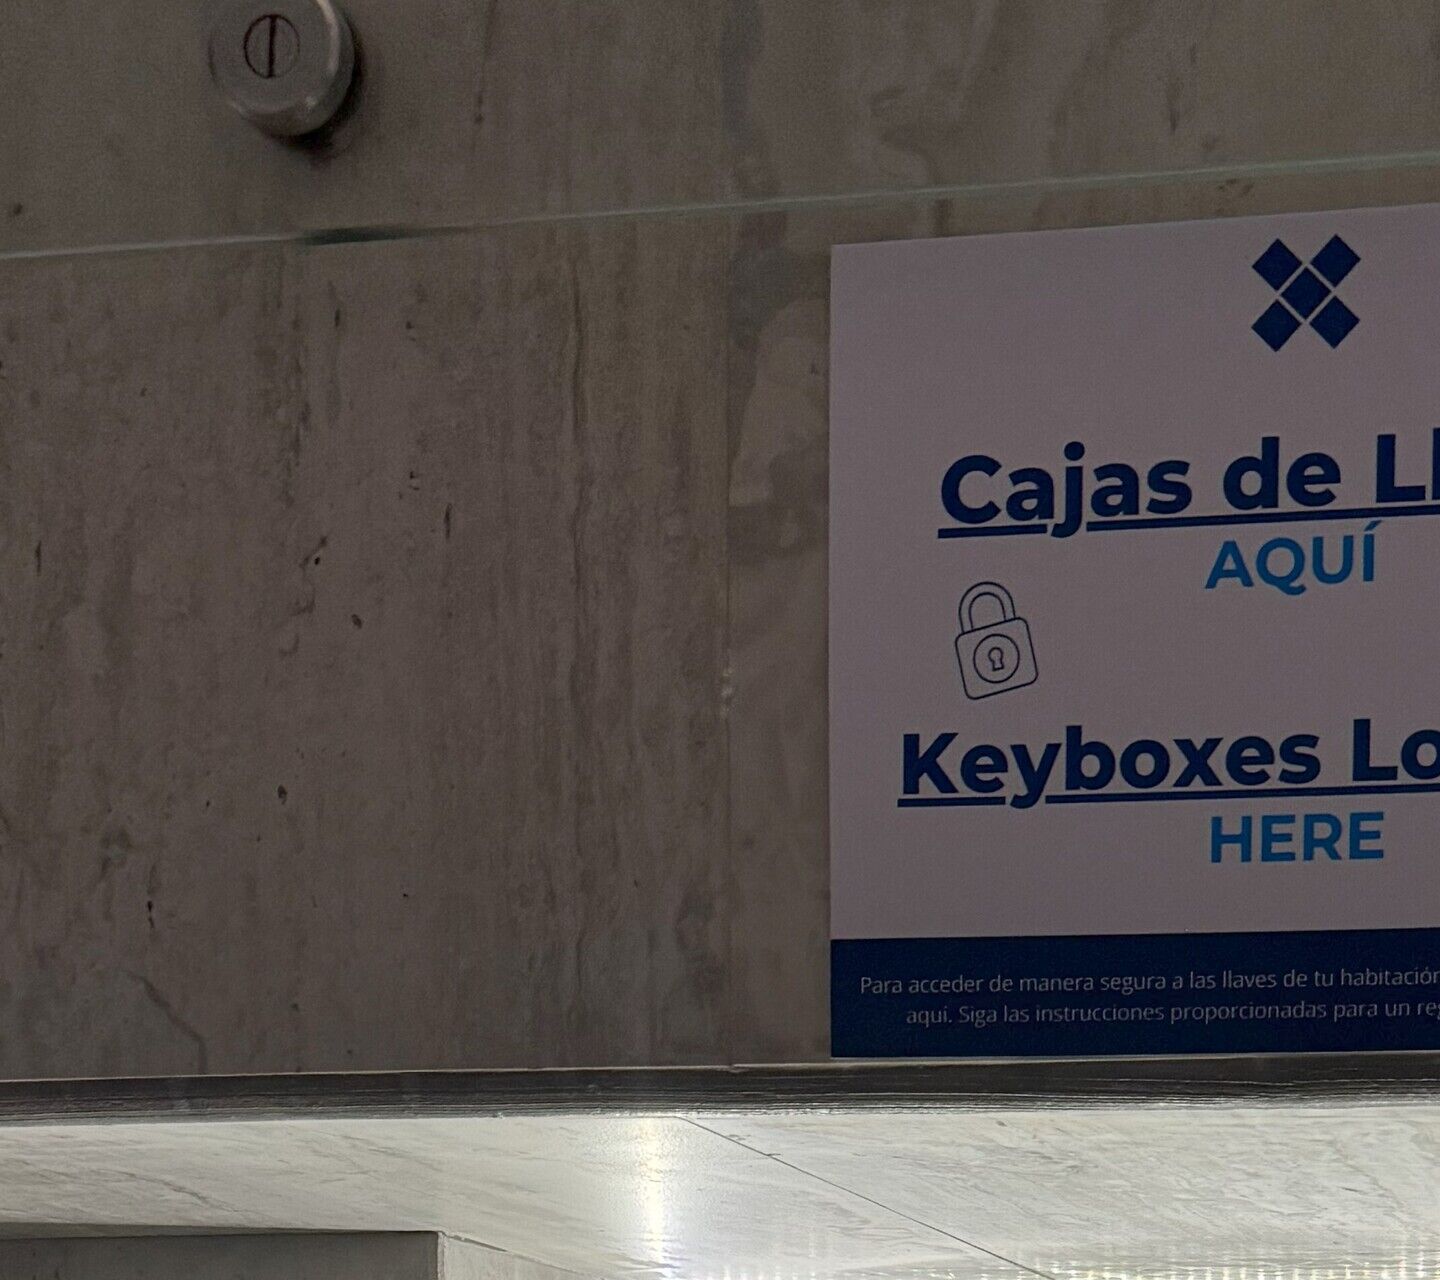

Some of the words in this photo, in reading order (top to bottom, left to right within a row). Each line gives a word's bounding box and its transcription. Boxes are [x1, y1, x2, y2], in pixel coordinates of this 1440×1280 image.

[940, 441, 1193, 540] Cajas
[1221, 436, 1341, 510] de
[1205, 521, 1379, 596] AQUÍ
[900, 724, 1321, 809] Keyboxes
[1209, 810, 1385, 864] HERE
[860, 975, 902, 994] Para
[908, 975, 984, 993] acceder
[989, 974, 1013, 992] de
[1019, 976, 1094, 992] manera
[1101, 975, 1166, 995] segura
[1172, 975, 1183, 990] a
[1190, 970, 1217, 990] las
[1223, 970, 1277, 989] llaves
[1283, 969, 1308, 988] de
[1315, 971, 1334, 987] tu
[906, 1006, 953, 1029] aquí.
[958, 1005, 998, 1028] Siga
[1003, 1004, 1030, 1023] las
[1035, 1002, 1165, 1023] instrucciones
[1170, 1000, 1327, 1025] proporcionadas
[1333, 1002, 1378, 1022] para
[1385, 1001, 1410, 1017] un
